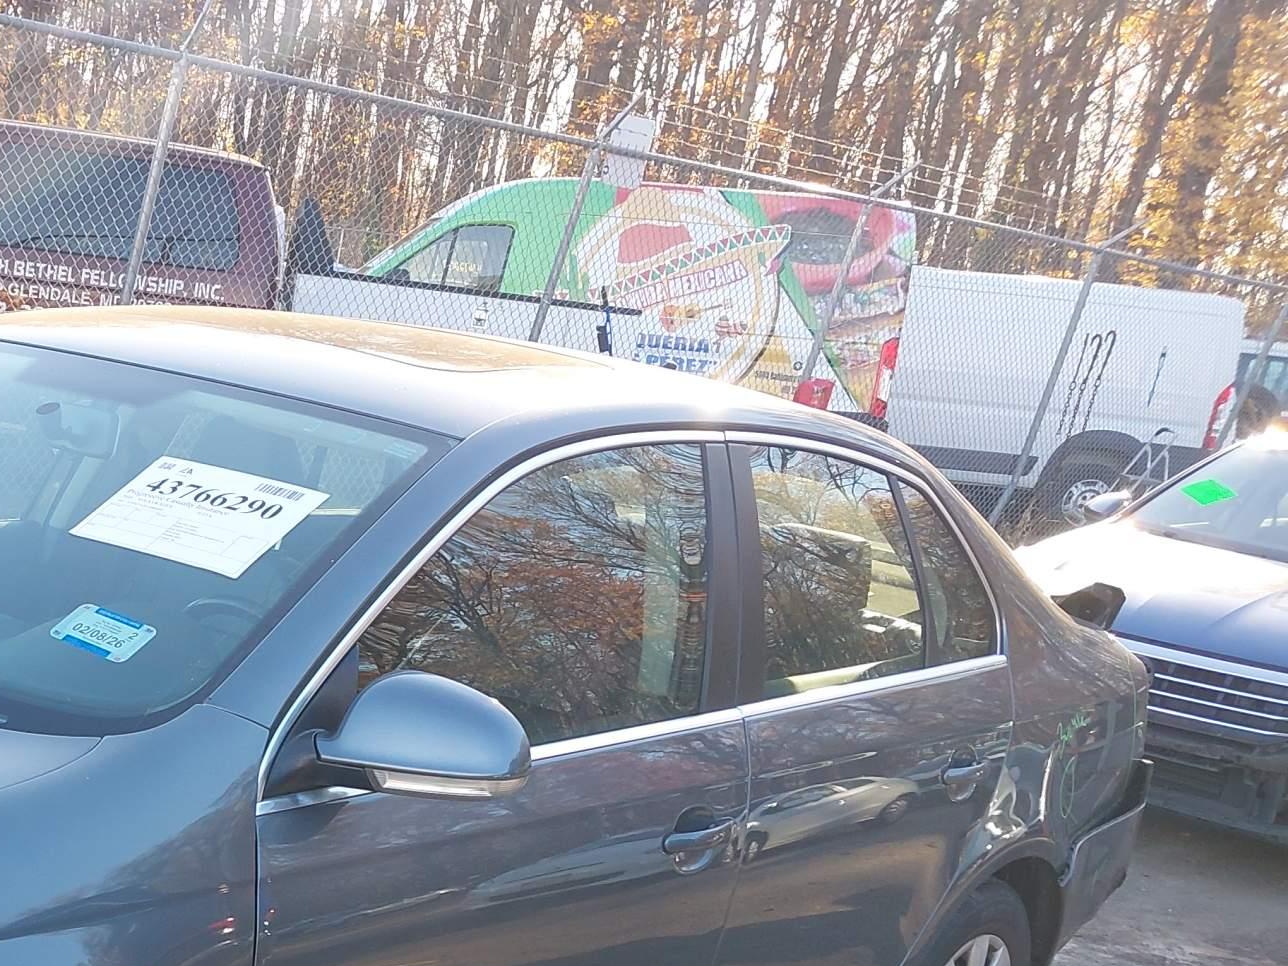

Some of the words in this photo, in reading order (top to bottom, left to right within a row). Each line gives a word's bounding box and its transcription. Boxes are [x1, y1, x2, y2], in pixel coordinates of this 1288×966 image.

[13, 260, 76, 283] BETHEL
[194, 282, 225, 301] INC.
[668, 259, 748, 298] MEXICANA
[146, 478, 283, 520] 43766290
[72, 622, 126, 649] 02/08/26
